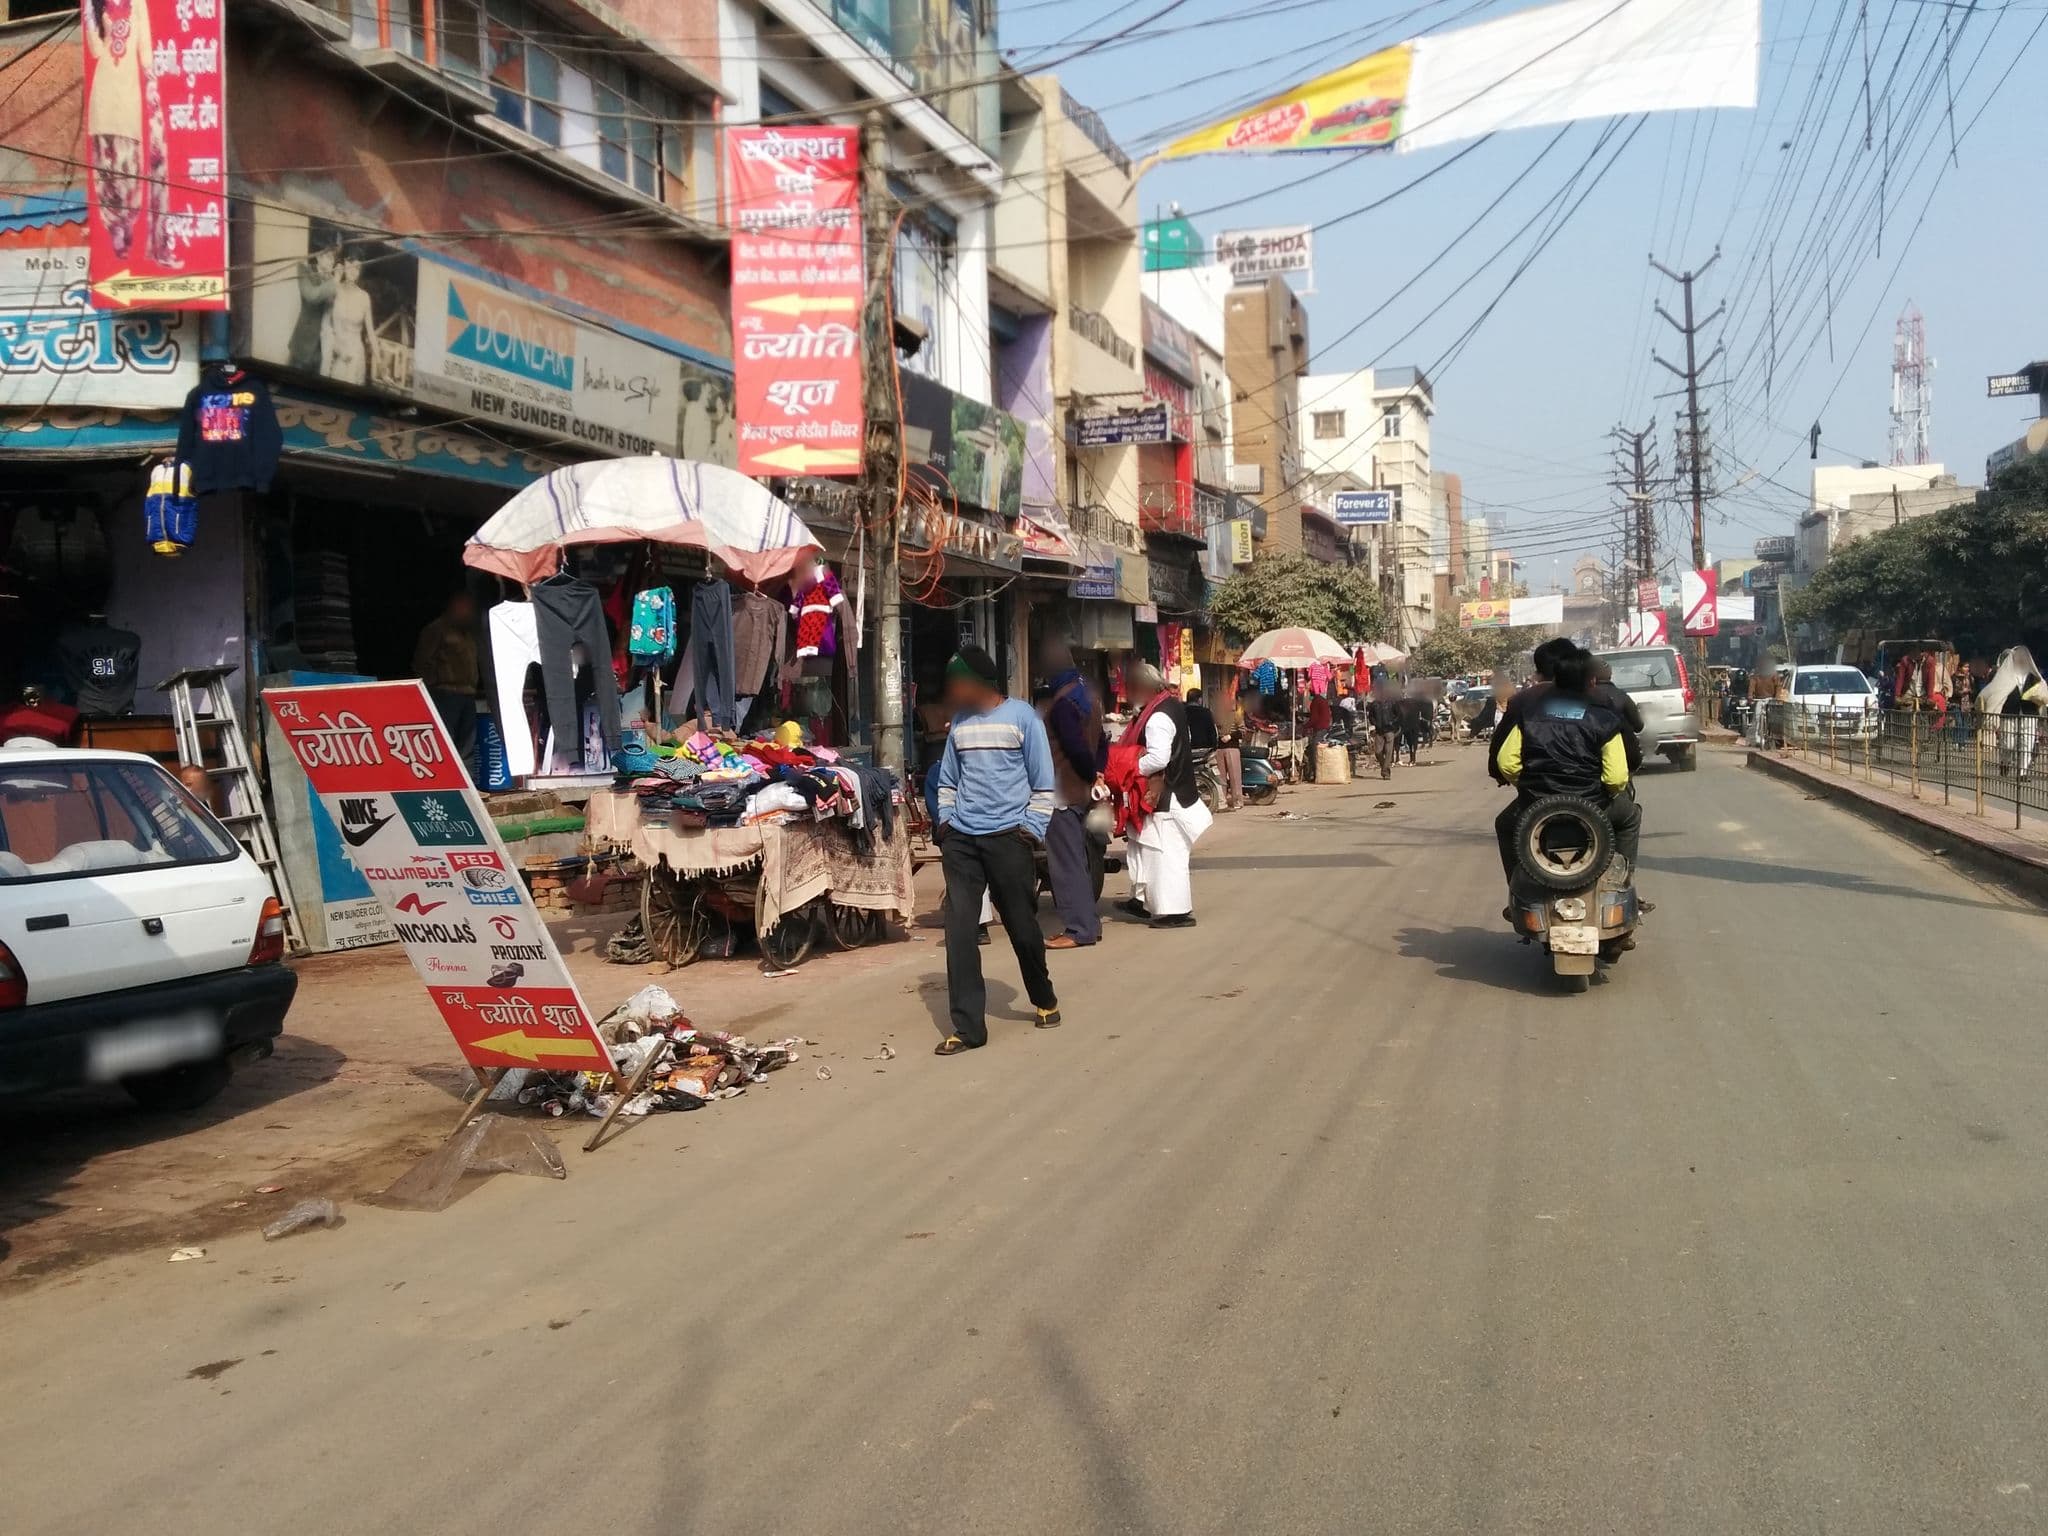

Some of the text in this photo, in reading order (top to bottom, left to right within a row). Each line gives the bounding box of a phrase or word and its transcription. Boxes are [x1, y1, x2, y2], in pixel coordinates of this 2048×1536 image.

[474, 300, 568, 379] DONEAR
[743, 323, 858, 359] ज्योति
[1990, 375, 2030, 388] SURPRISE
[766, 379, 839, 416] शूज
[471, 388, 507, 415] NEW
[511, 400, 568, 433] SUNDER
[572, 419, 614, 446] CLOTH
[1336, 496, 1389, 509] Forever 21
[1238, 522, 1251, 561] Nikon
[92, 658, 115, 675] 91
[274, 701, 310, 723] न्यू
[290, 711, 443, 779] ज्योति शूज
[339, 798, 379, 825] NIKE
[412, 819, 476, 837] WOODLAND
[454, 853, 495, 866] RED
[364, 866, 451, 881] COLUMBUS
[468, 892, 517, 903] CHIEF
[330, 910, 344, 921] NEW
[344, 907, 369, 920] SUNDER
[394, 923, 478, 944] NICHOLAS
[490, 944, 547, 960] PROZONE
[441, 992, 474, 1010] न्यू
[475, 996, 582, 1035] ज्योति शूज
